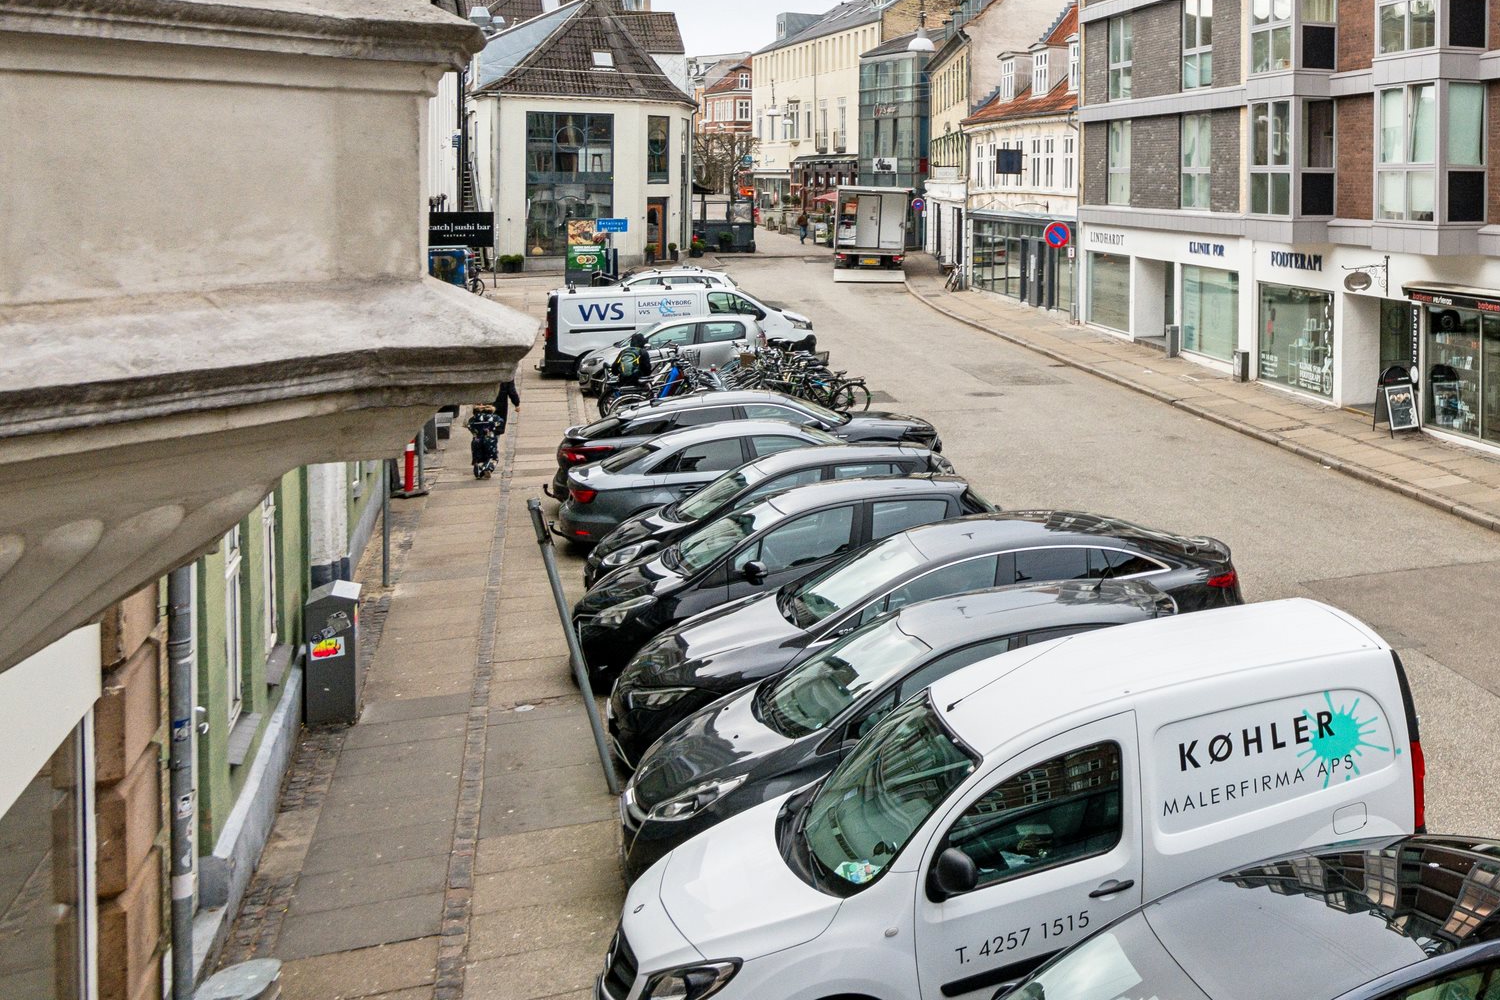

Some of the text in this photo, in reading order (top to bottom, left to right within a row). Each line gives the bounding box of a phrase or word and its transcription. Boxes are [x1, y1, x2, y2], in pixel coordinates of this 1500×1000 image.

[429, 223, 450, 231] catch
[454, 223, 475, 231] sushi
[476, 223, 491, 231] bar
[1090, 231, 1125, 247] LINDHARDT
[1189, 241, 1225, 257] KLINIK FOR
[1270, 251, 1323, 272] FODTERAPI
[1412, 292, 1432, 302] barberen
[578, 302, 624, 322] VVS
[1477, 301, 1500, 312] barberen
[1178, 710, 1337, 773] KØHLER
[1162, 753, 1355, 817] MALERFIRMA APS
[954, 909, 1091, 965] T. 4257 1515
